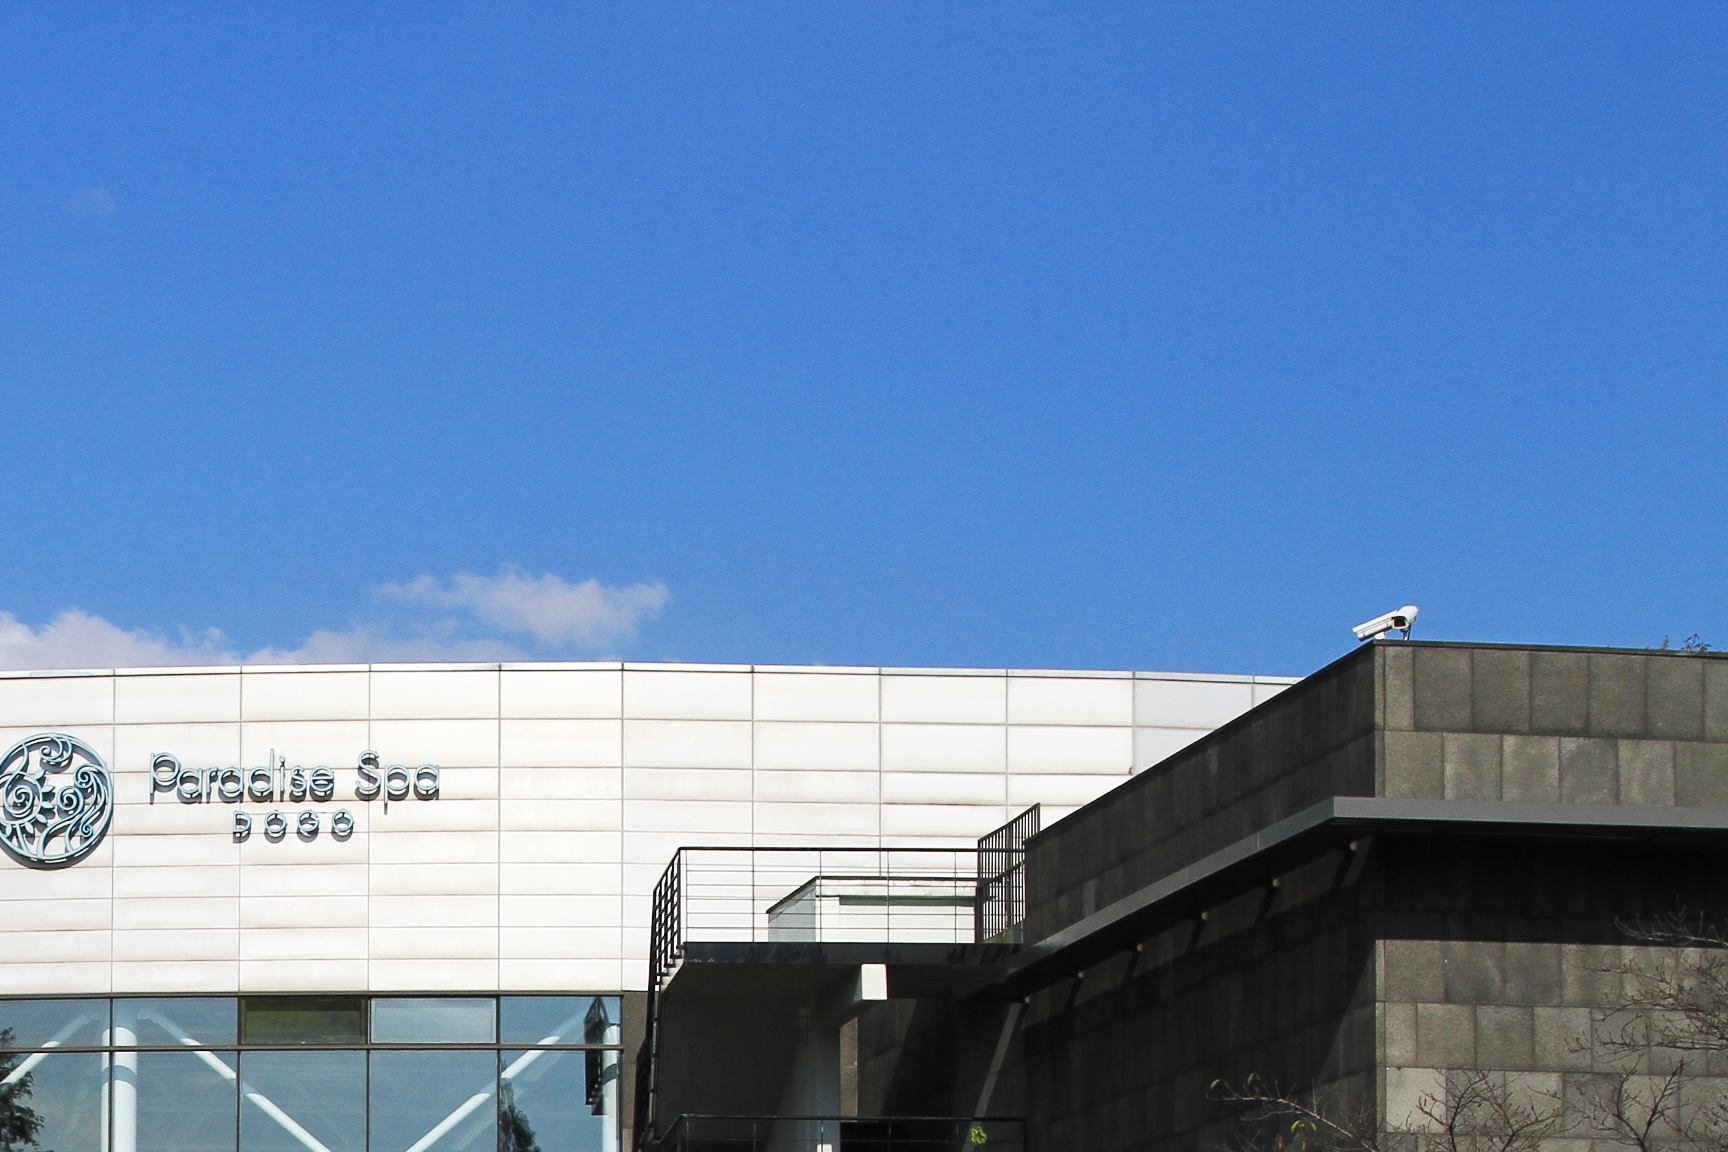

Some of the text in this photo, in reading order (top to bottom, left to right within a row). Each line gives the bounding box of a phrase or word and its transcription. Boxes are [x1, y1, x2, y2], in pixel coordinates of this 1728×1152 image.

[149, 748, 441, 806] Paradise Spa
[232, 808, 355, 836] DOGO
